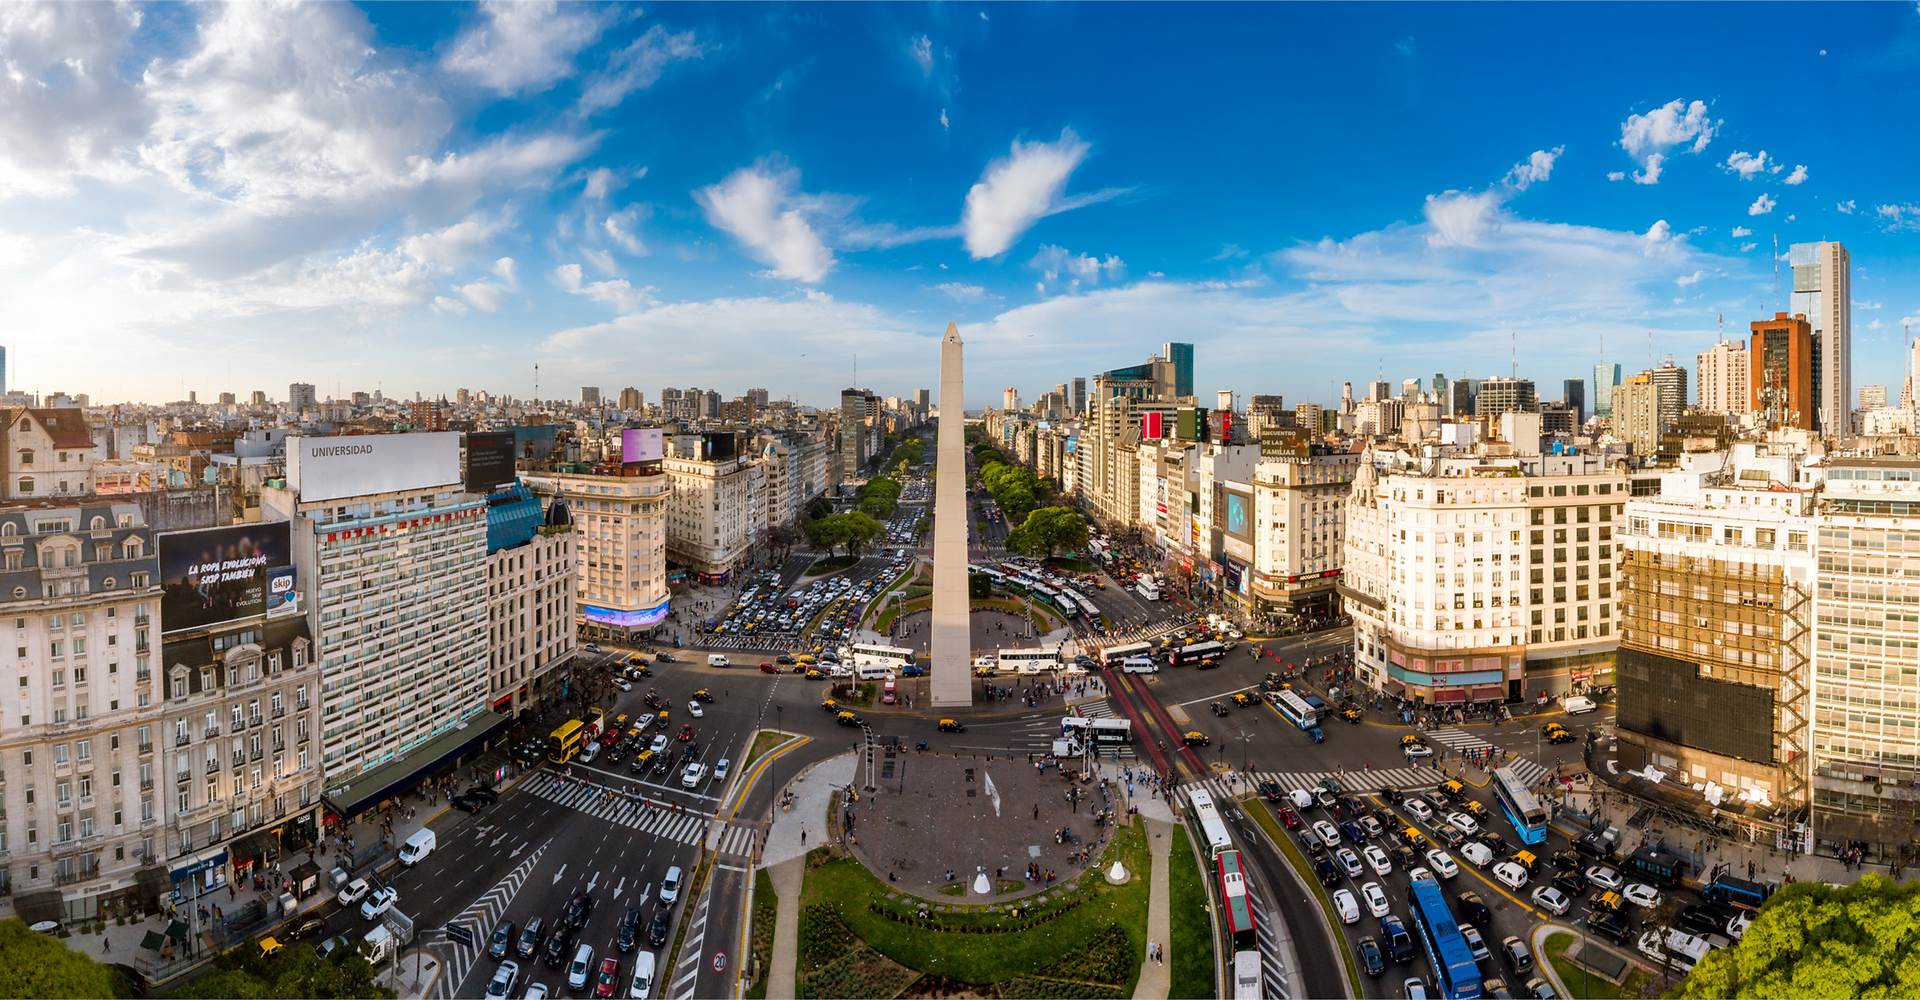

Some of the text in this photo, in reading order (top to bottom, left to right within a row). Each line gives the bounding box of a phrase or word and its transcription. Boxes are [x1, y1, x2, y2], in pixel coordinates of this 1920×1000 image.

[311, 444, 373, 458] UNIVERSIDAD
[1262, 448, 1296, 456] FAMILIAS
[327, 525, 388, 542] HOTEL
[188, 564, 199, 575] LA
[200, 561, 220, 574] ROPA
[201, 573, 220, 585] SKIP
[273, 578, 291, 589] skip
[235, 598, 262, 608] EVOLUTION
[715, 955, 726, 969] 20
